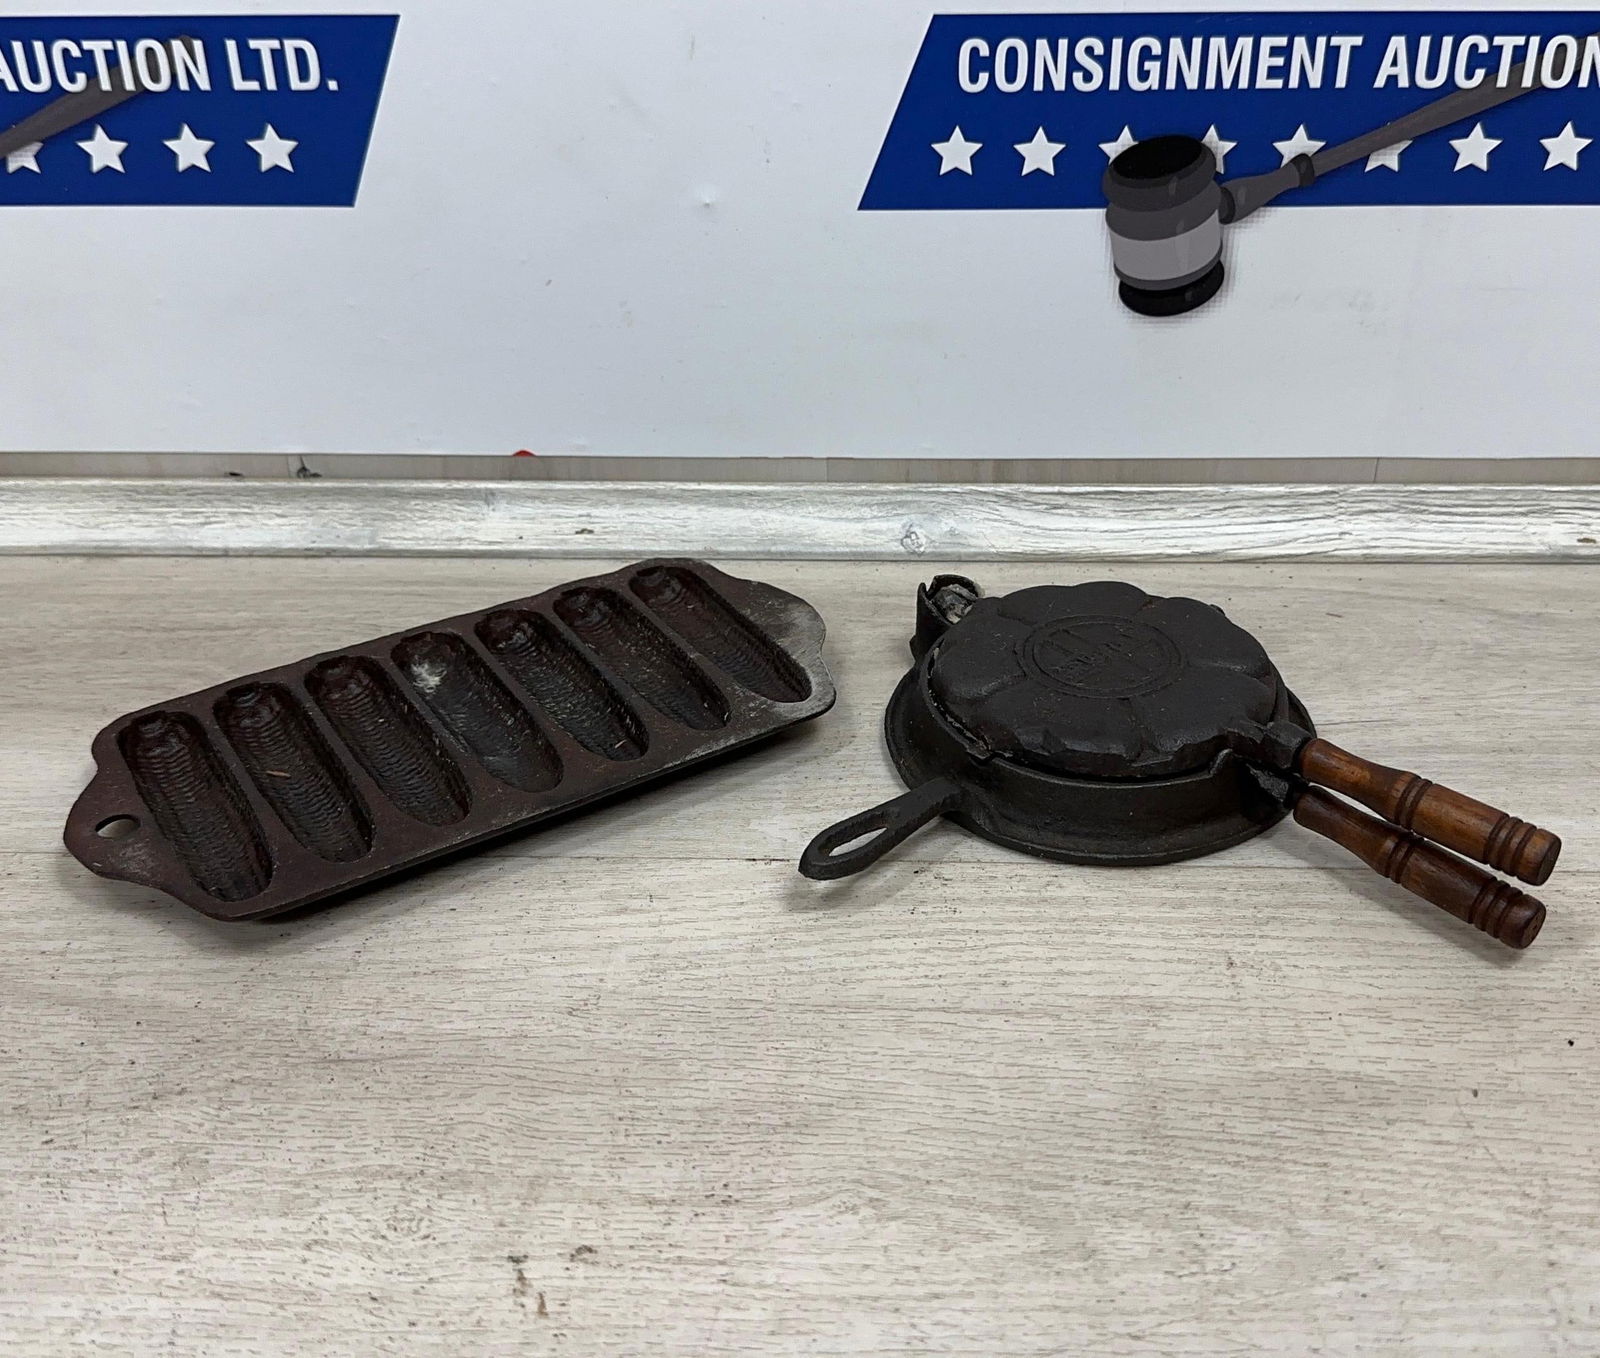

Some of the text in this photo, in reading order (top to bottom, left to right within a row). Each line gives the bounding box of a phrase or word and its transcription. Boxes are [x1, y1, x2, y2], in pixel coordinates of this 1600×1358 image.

[225, 39, 338, 91] LTD.
[958, 35, 1600, 93] CONSIGNMENT AUCTION
